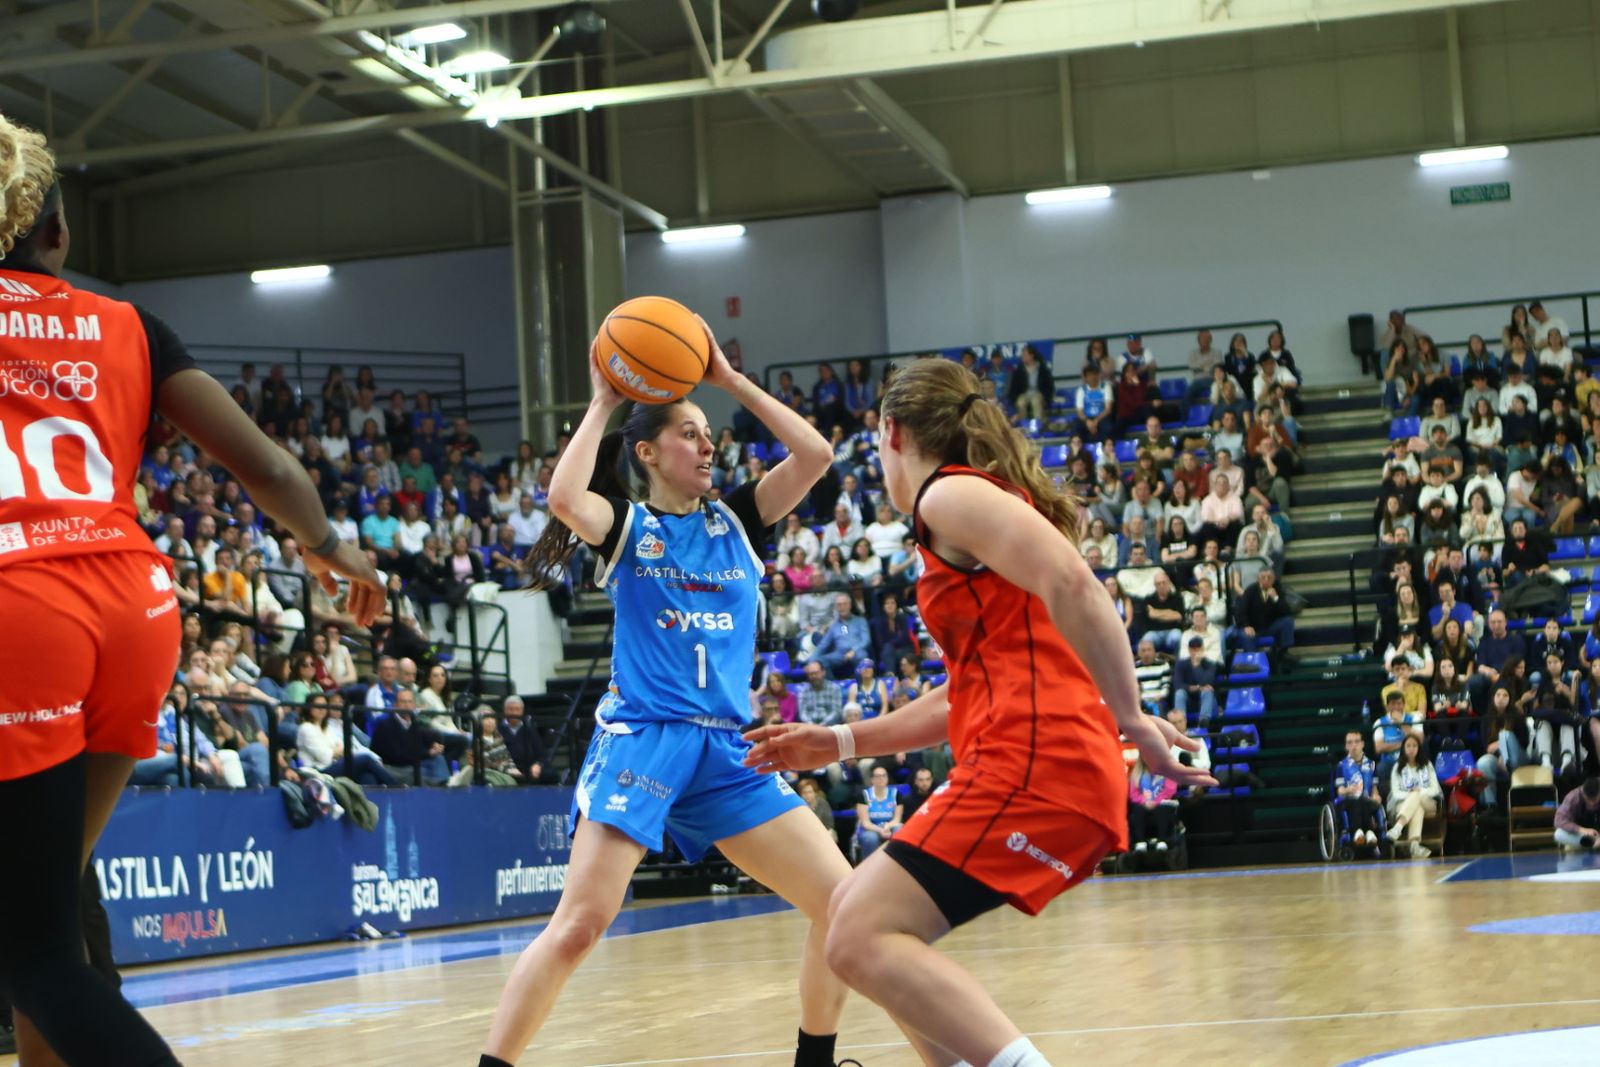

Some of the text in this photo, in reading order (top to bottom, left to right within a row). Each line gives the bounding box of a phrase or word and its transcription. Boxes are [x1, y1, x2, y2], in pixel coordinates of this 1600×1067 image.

[0, 416, 115, 503] 10
[30, 517, 96, 534] XUNTA
[32, 527, 127, 547] DE GALICIA
[635, 565, 747, 583] CASTILLA Y LEÓN
[694, 643, 707, 689] 1
[198, 853, 211, 904] Y
[217, 836, 274, 892] LEÓN
[132, 913, 162, 938] NOS
